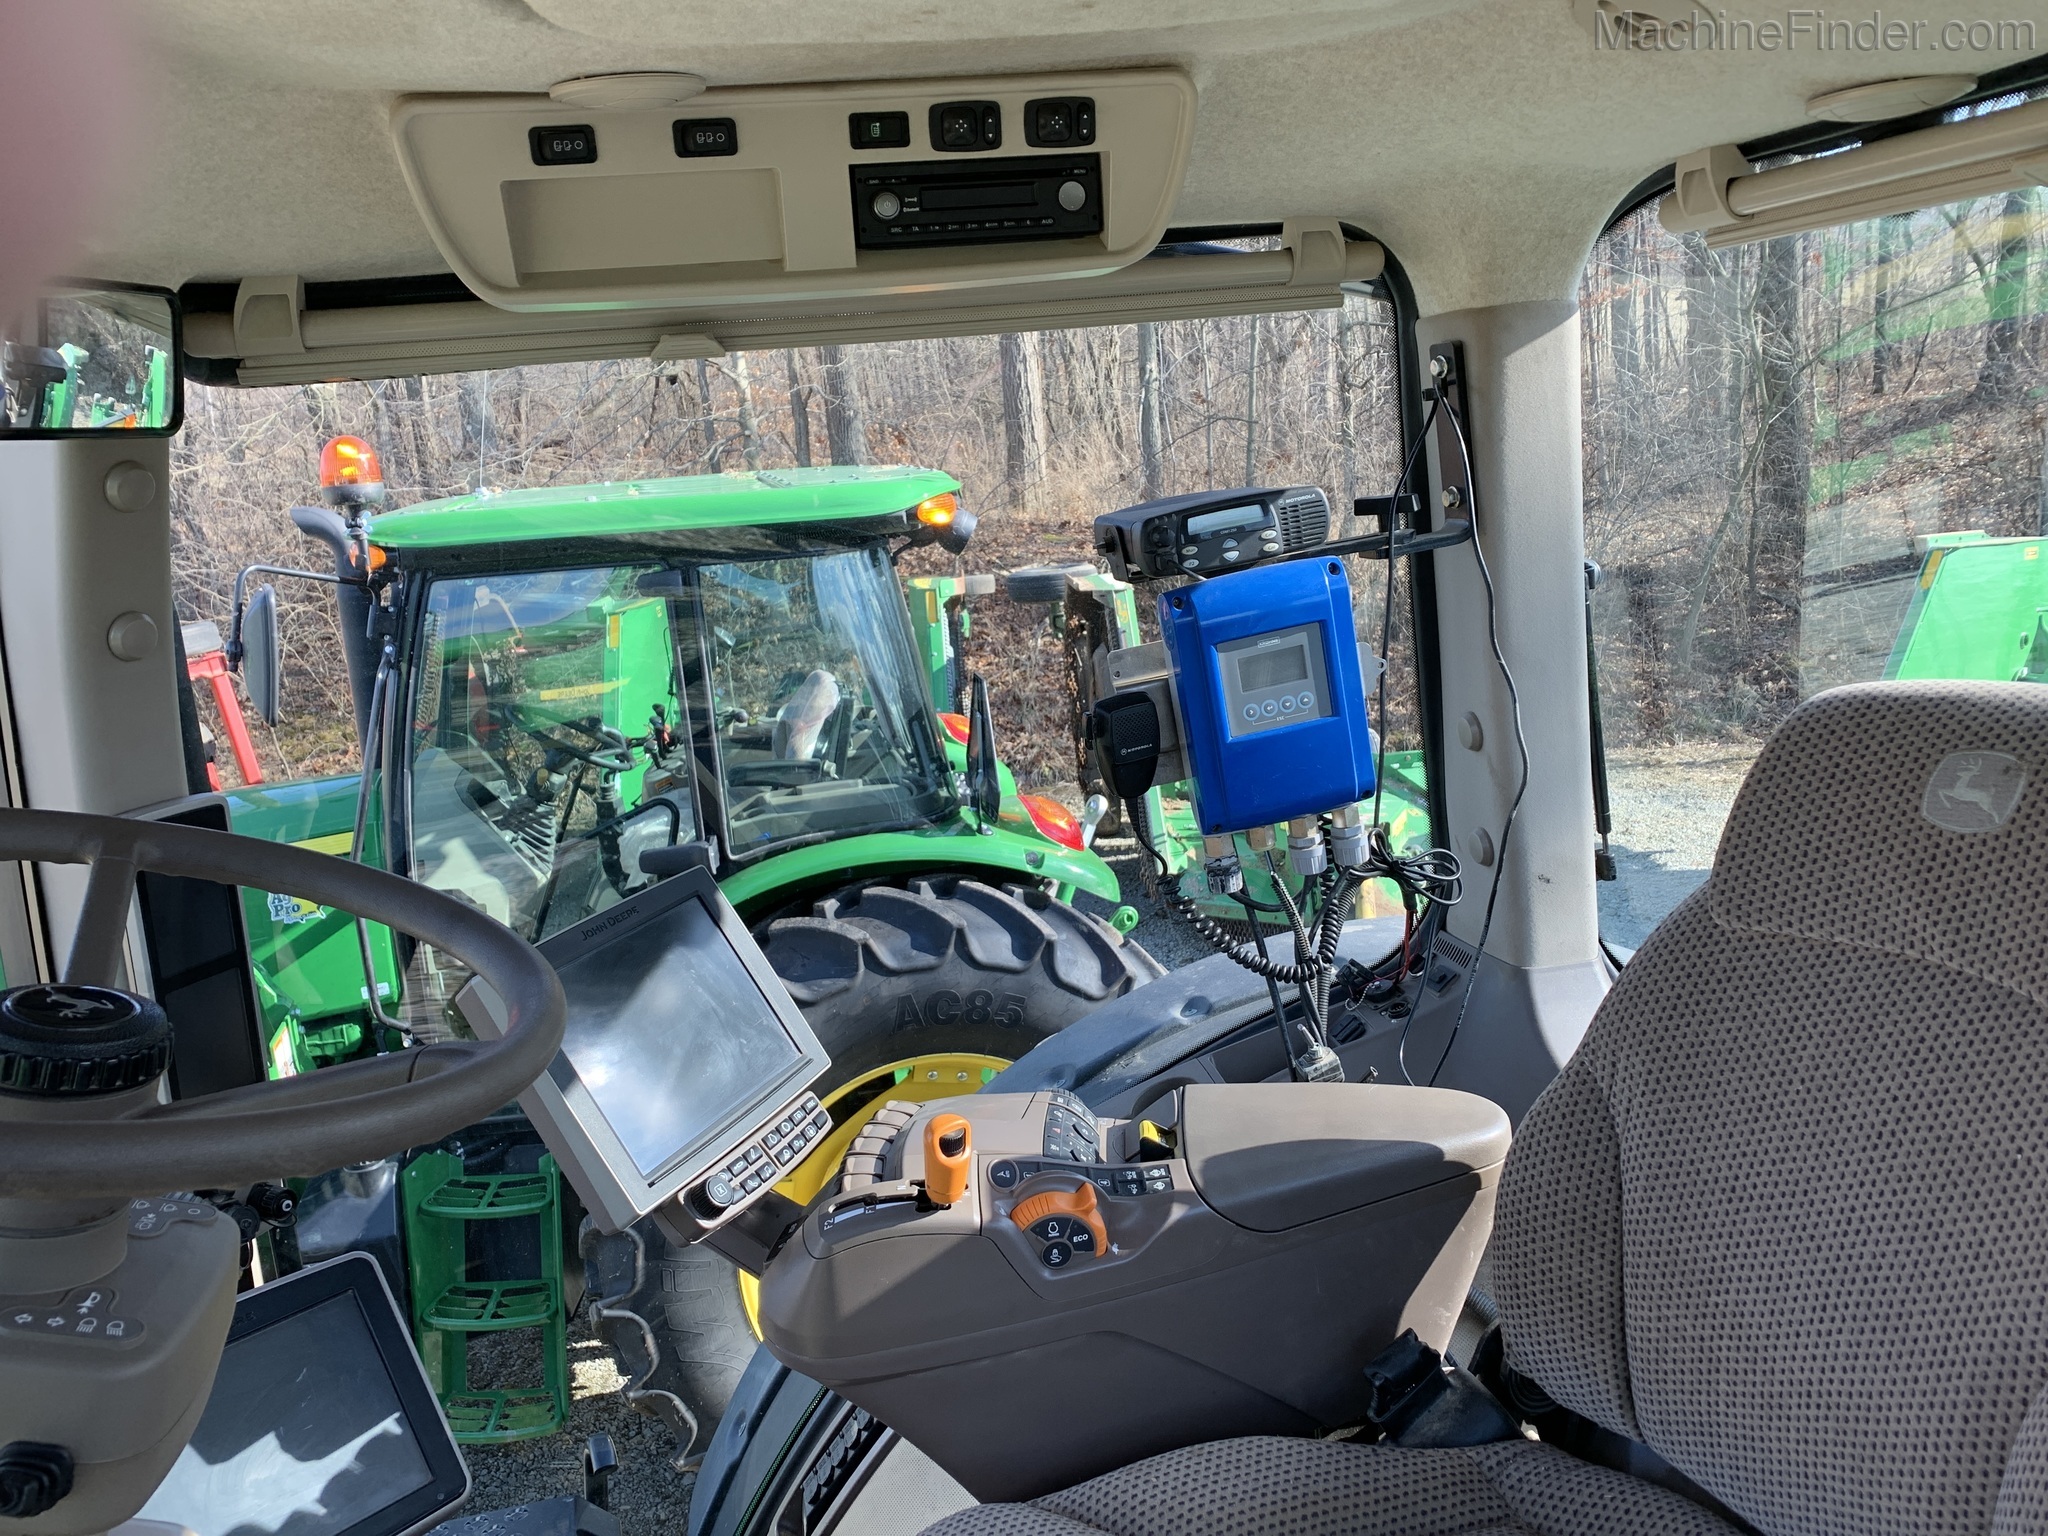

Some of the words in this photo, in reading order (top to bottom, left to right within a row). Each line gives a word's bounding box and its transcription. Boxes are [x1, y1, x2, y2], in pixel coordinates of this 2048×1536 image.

[1285, 493, 1316, 503] MOTOROLA
[272, 903, 301, 917] Pro
[581, 921, 609, 942] JOHN
[607, 905, 640, 928] DEERE
[893, 987, 1028, 1032] AC85
[823, 1217, 834, 1231] F2
[1073, 1233, 1089, 1243] ECO
